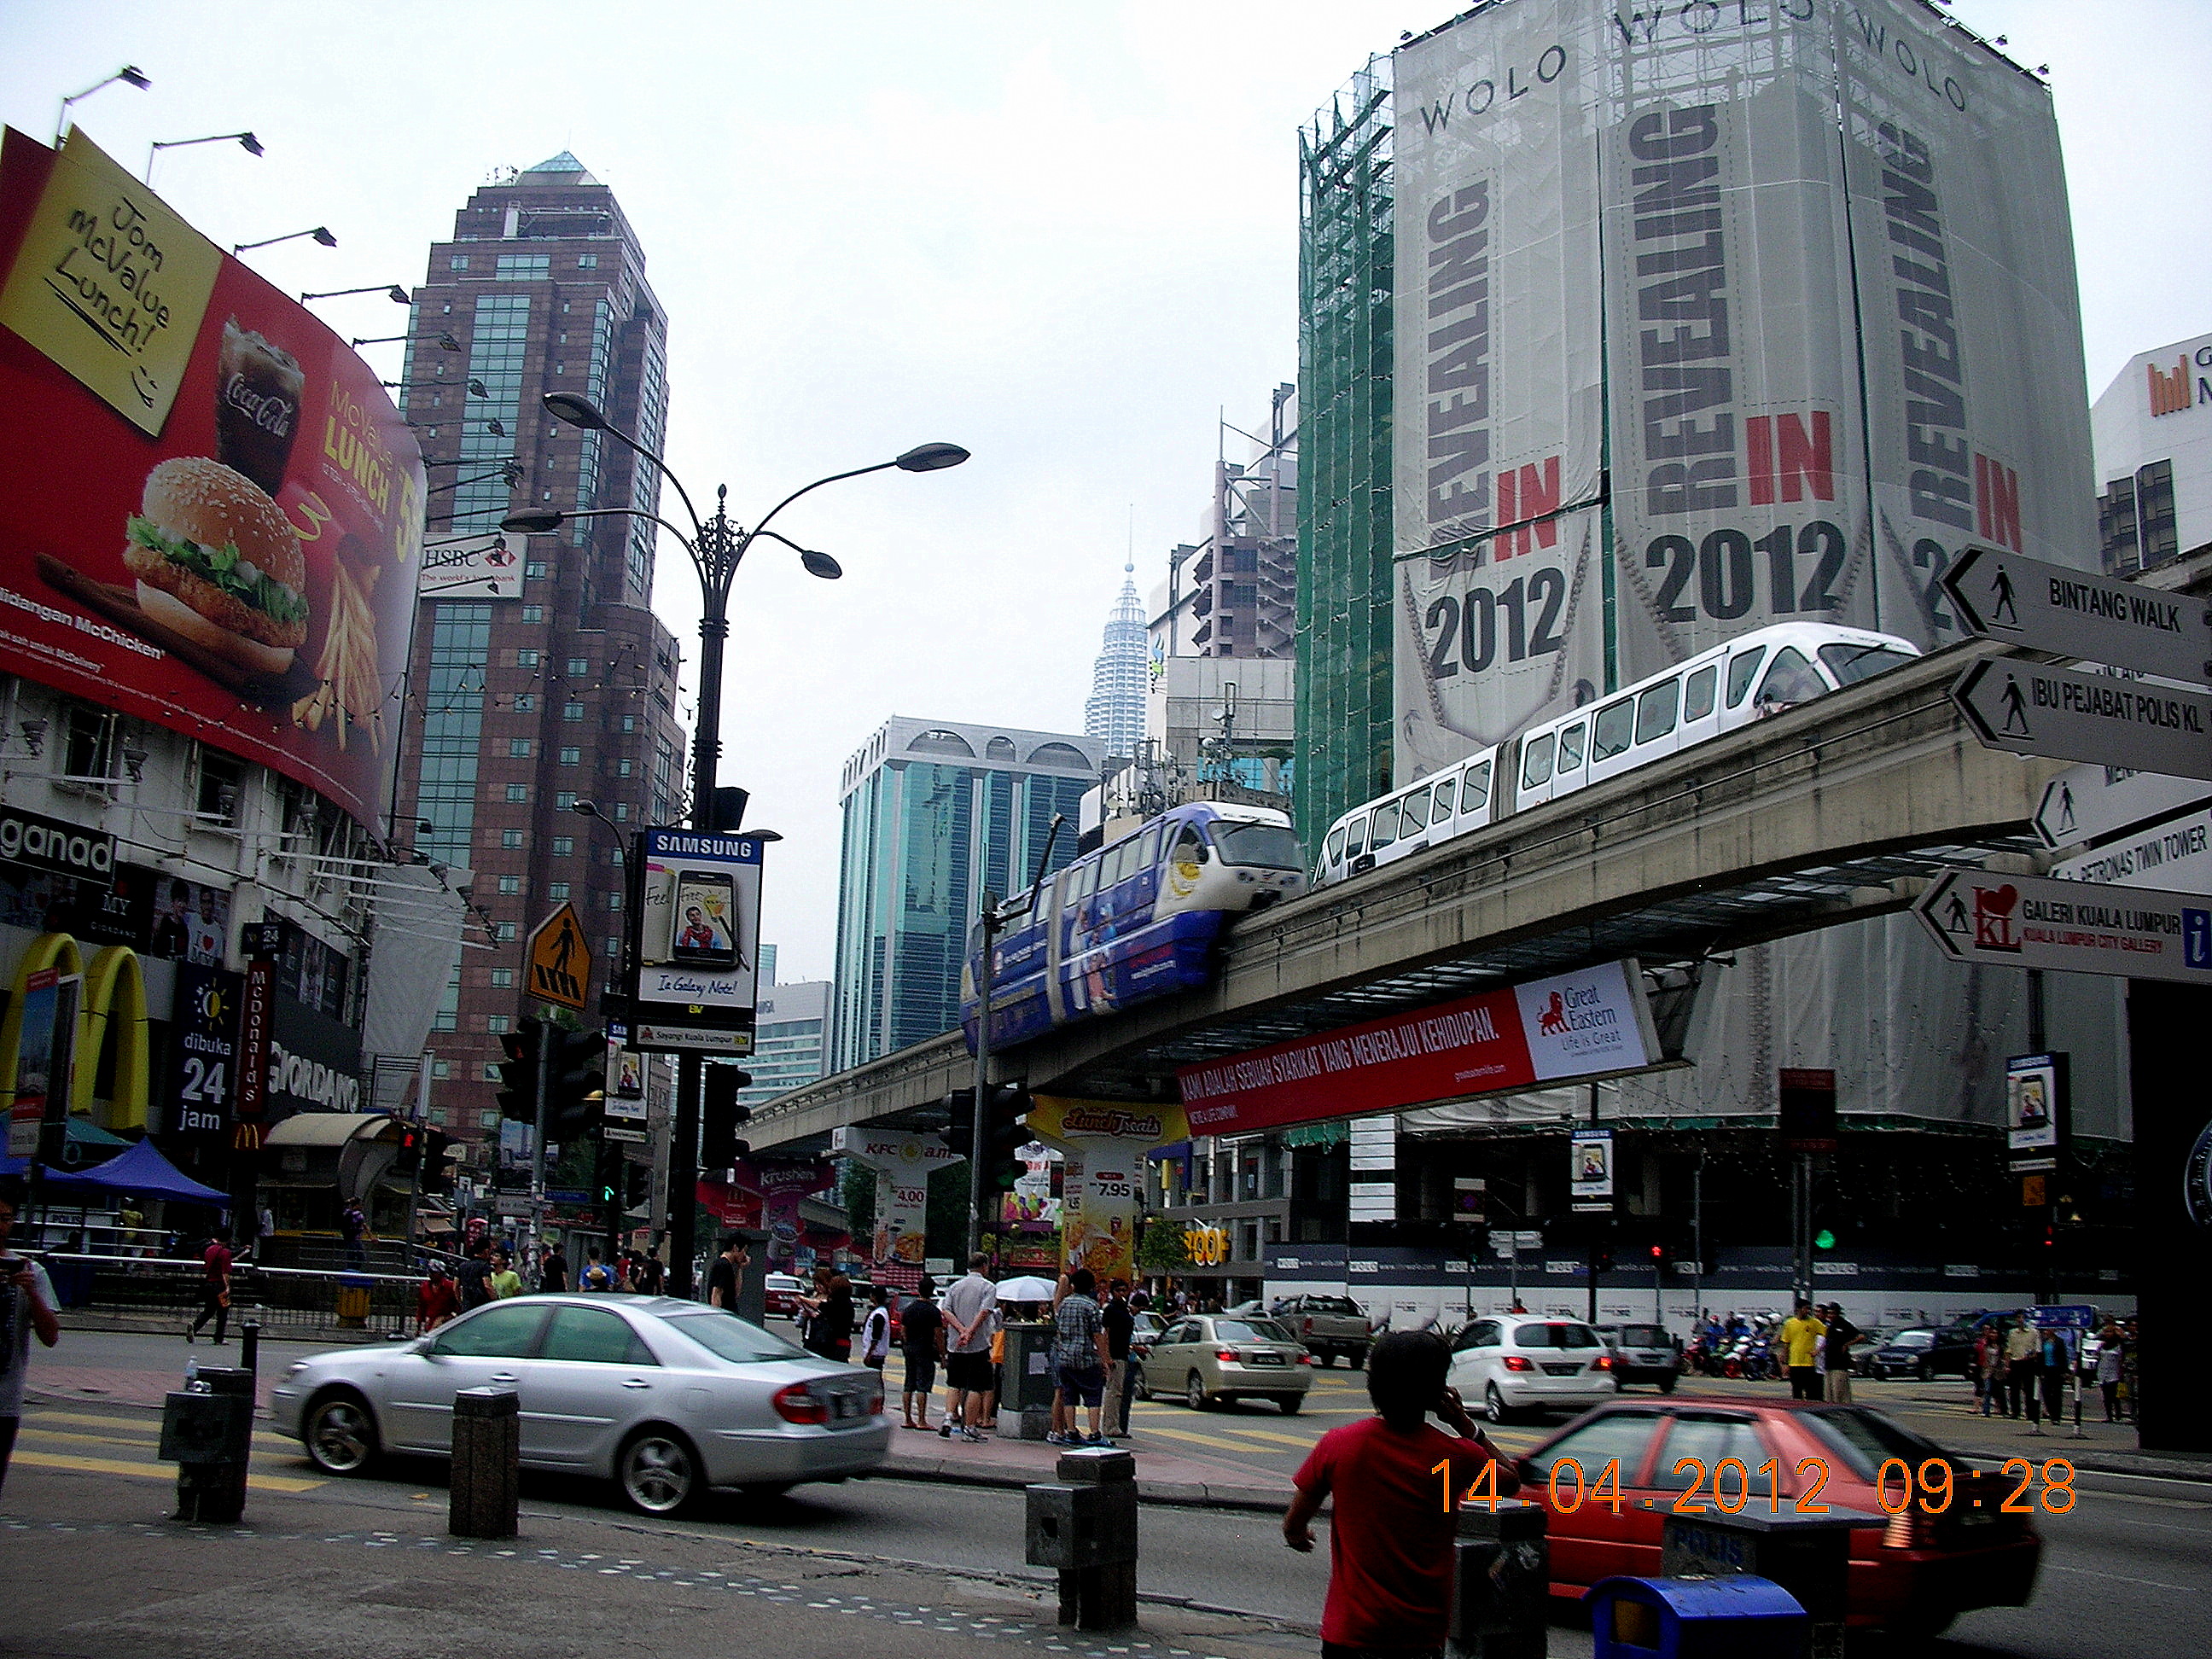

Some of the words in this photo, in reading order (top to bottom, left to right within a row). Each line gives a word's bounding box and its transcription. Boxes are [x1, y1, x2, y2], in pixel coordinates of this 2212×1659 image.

[1855, 8, 1968, 113] WOLO
[1419, 44, 1567, 137] WOLO
[113, 196, 166, 273] Jom
[68, 207, 172, 329] McValue
[55, 247, 156, 353] Lunch!
[1627, 104, 1738, 516] REVEALING
[1877, 121, 1973, 532] REVEALING
[324, 416, 390, 515] LUNCH
[1745, 410, 1835, 507] IN
[1493, 455, 1560, 562] IN
[1974, 451, 2023, 555] IN
[425, 550, 480, 568] HSBC
[1645, 519, 1847, 624] 2012
[1425, 565, 1565, 681] 2012
[2048, 577, 2127, 621] BINTANG
[2130, 596, 2181, 633] WALK
[2032, 677, 2059, 709] IBU
[2063, 682, 2133, 721] PEJABAT
[2136, 695, 2180, 729] POLIS
[2182, 703, 2204, 734] KL
[656, 834, 753, 859] SAMSUNG
[2163, 824, 2208, 861] TOWER
[90, 921, 137, 939] GIORDANO
[1973, 914, 2022, 948] KL
[2023, 899, 2075, 926] GALERI
[2076, 905, 2125, 930] KUALA
[2126, 908, 2183, 935] LUMPUR
[1564, 985, 1601, 1008] Great
[1568, 1008, 1617, 1031] Eastern
[184, 1032, 231, 1057] dibuka
[245, 969, 266, 1102] McDonald's
[1272, 1045, 1323, 1082] SYARIKAT
[1321, 1039, 1352, 1073] YANG
[1348, 1023, 1423, 1067] MENERAJUI
[1417, 1007, 1499, 1055] KEHIDUPAN.
[1592, 1030, 1621, 1045] Great
[181, 1057, 226, 1104] 24
[268, 1039, 360, 1114] GIORDANO
[178, 1104, 221, 1132] jam
[865, 1143, 898, 1155] KFC
[897, 1190, 925, 1202] 4.00
[1098, 1183, 1131, 1196] 7.95
